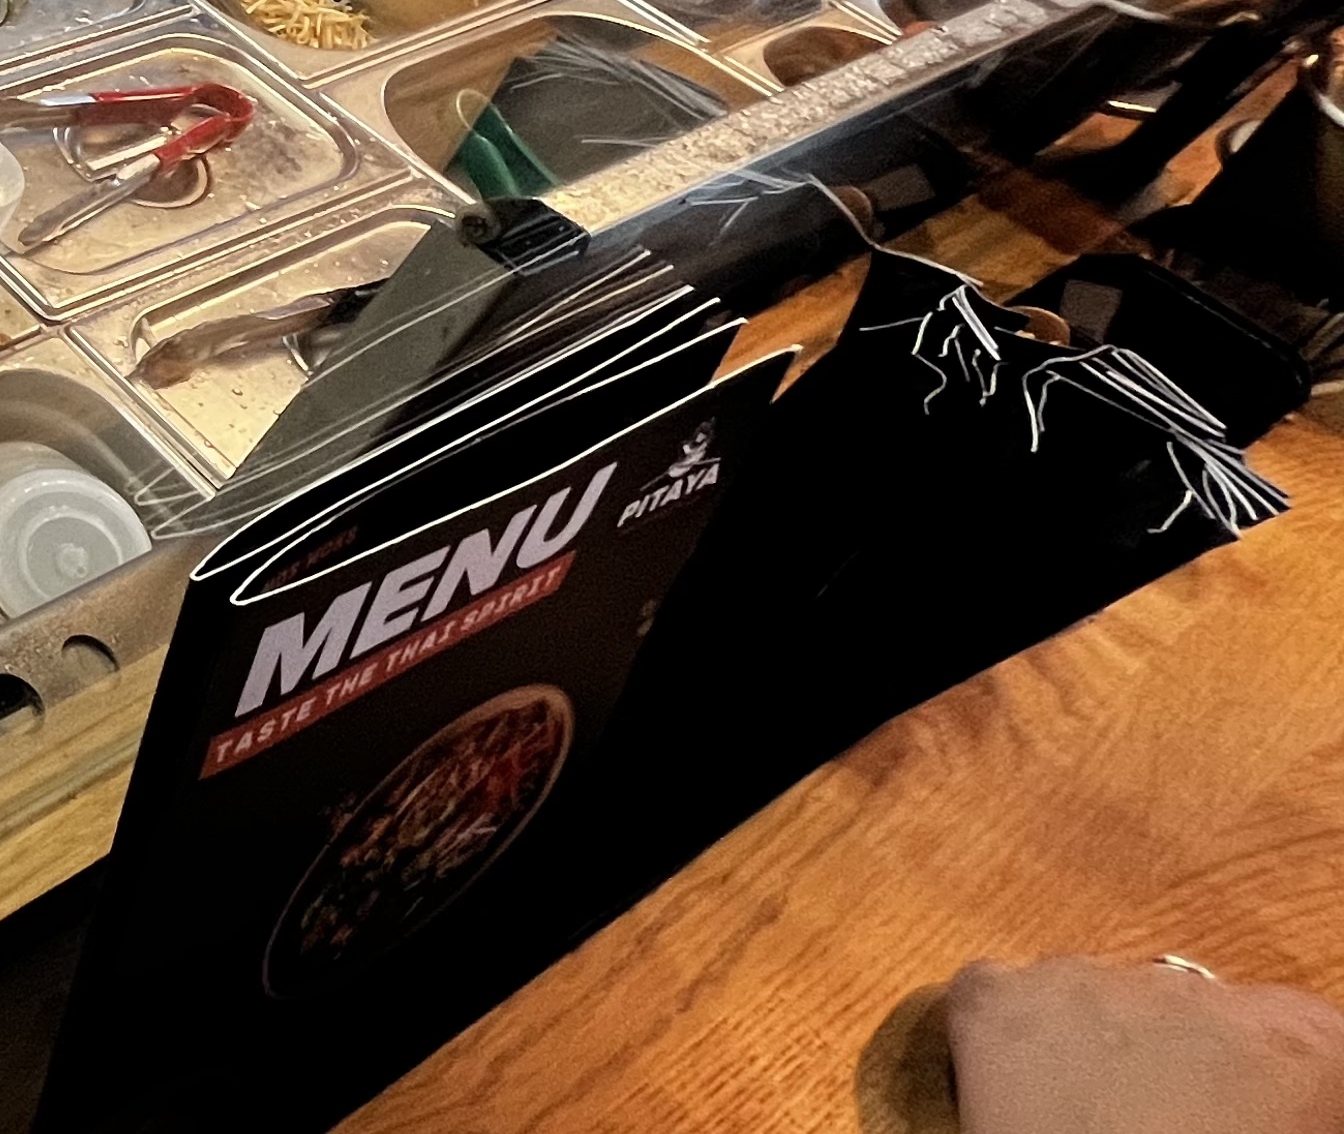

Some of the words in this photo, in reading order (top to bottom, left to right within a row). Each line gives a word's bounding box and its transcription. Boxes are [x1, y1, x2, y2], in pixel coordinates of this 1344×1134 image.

[234, 461, 618, 719] MENU
[616, 462, 720, 528] PITAYA
[216, 697, 317, 764] TASTE
[325, 666, 375, 707] THE
[386, 622, 459, 672] THAI
[461, 566, 563, 632] SPIRIT
